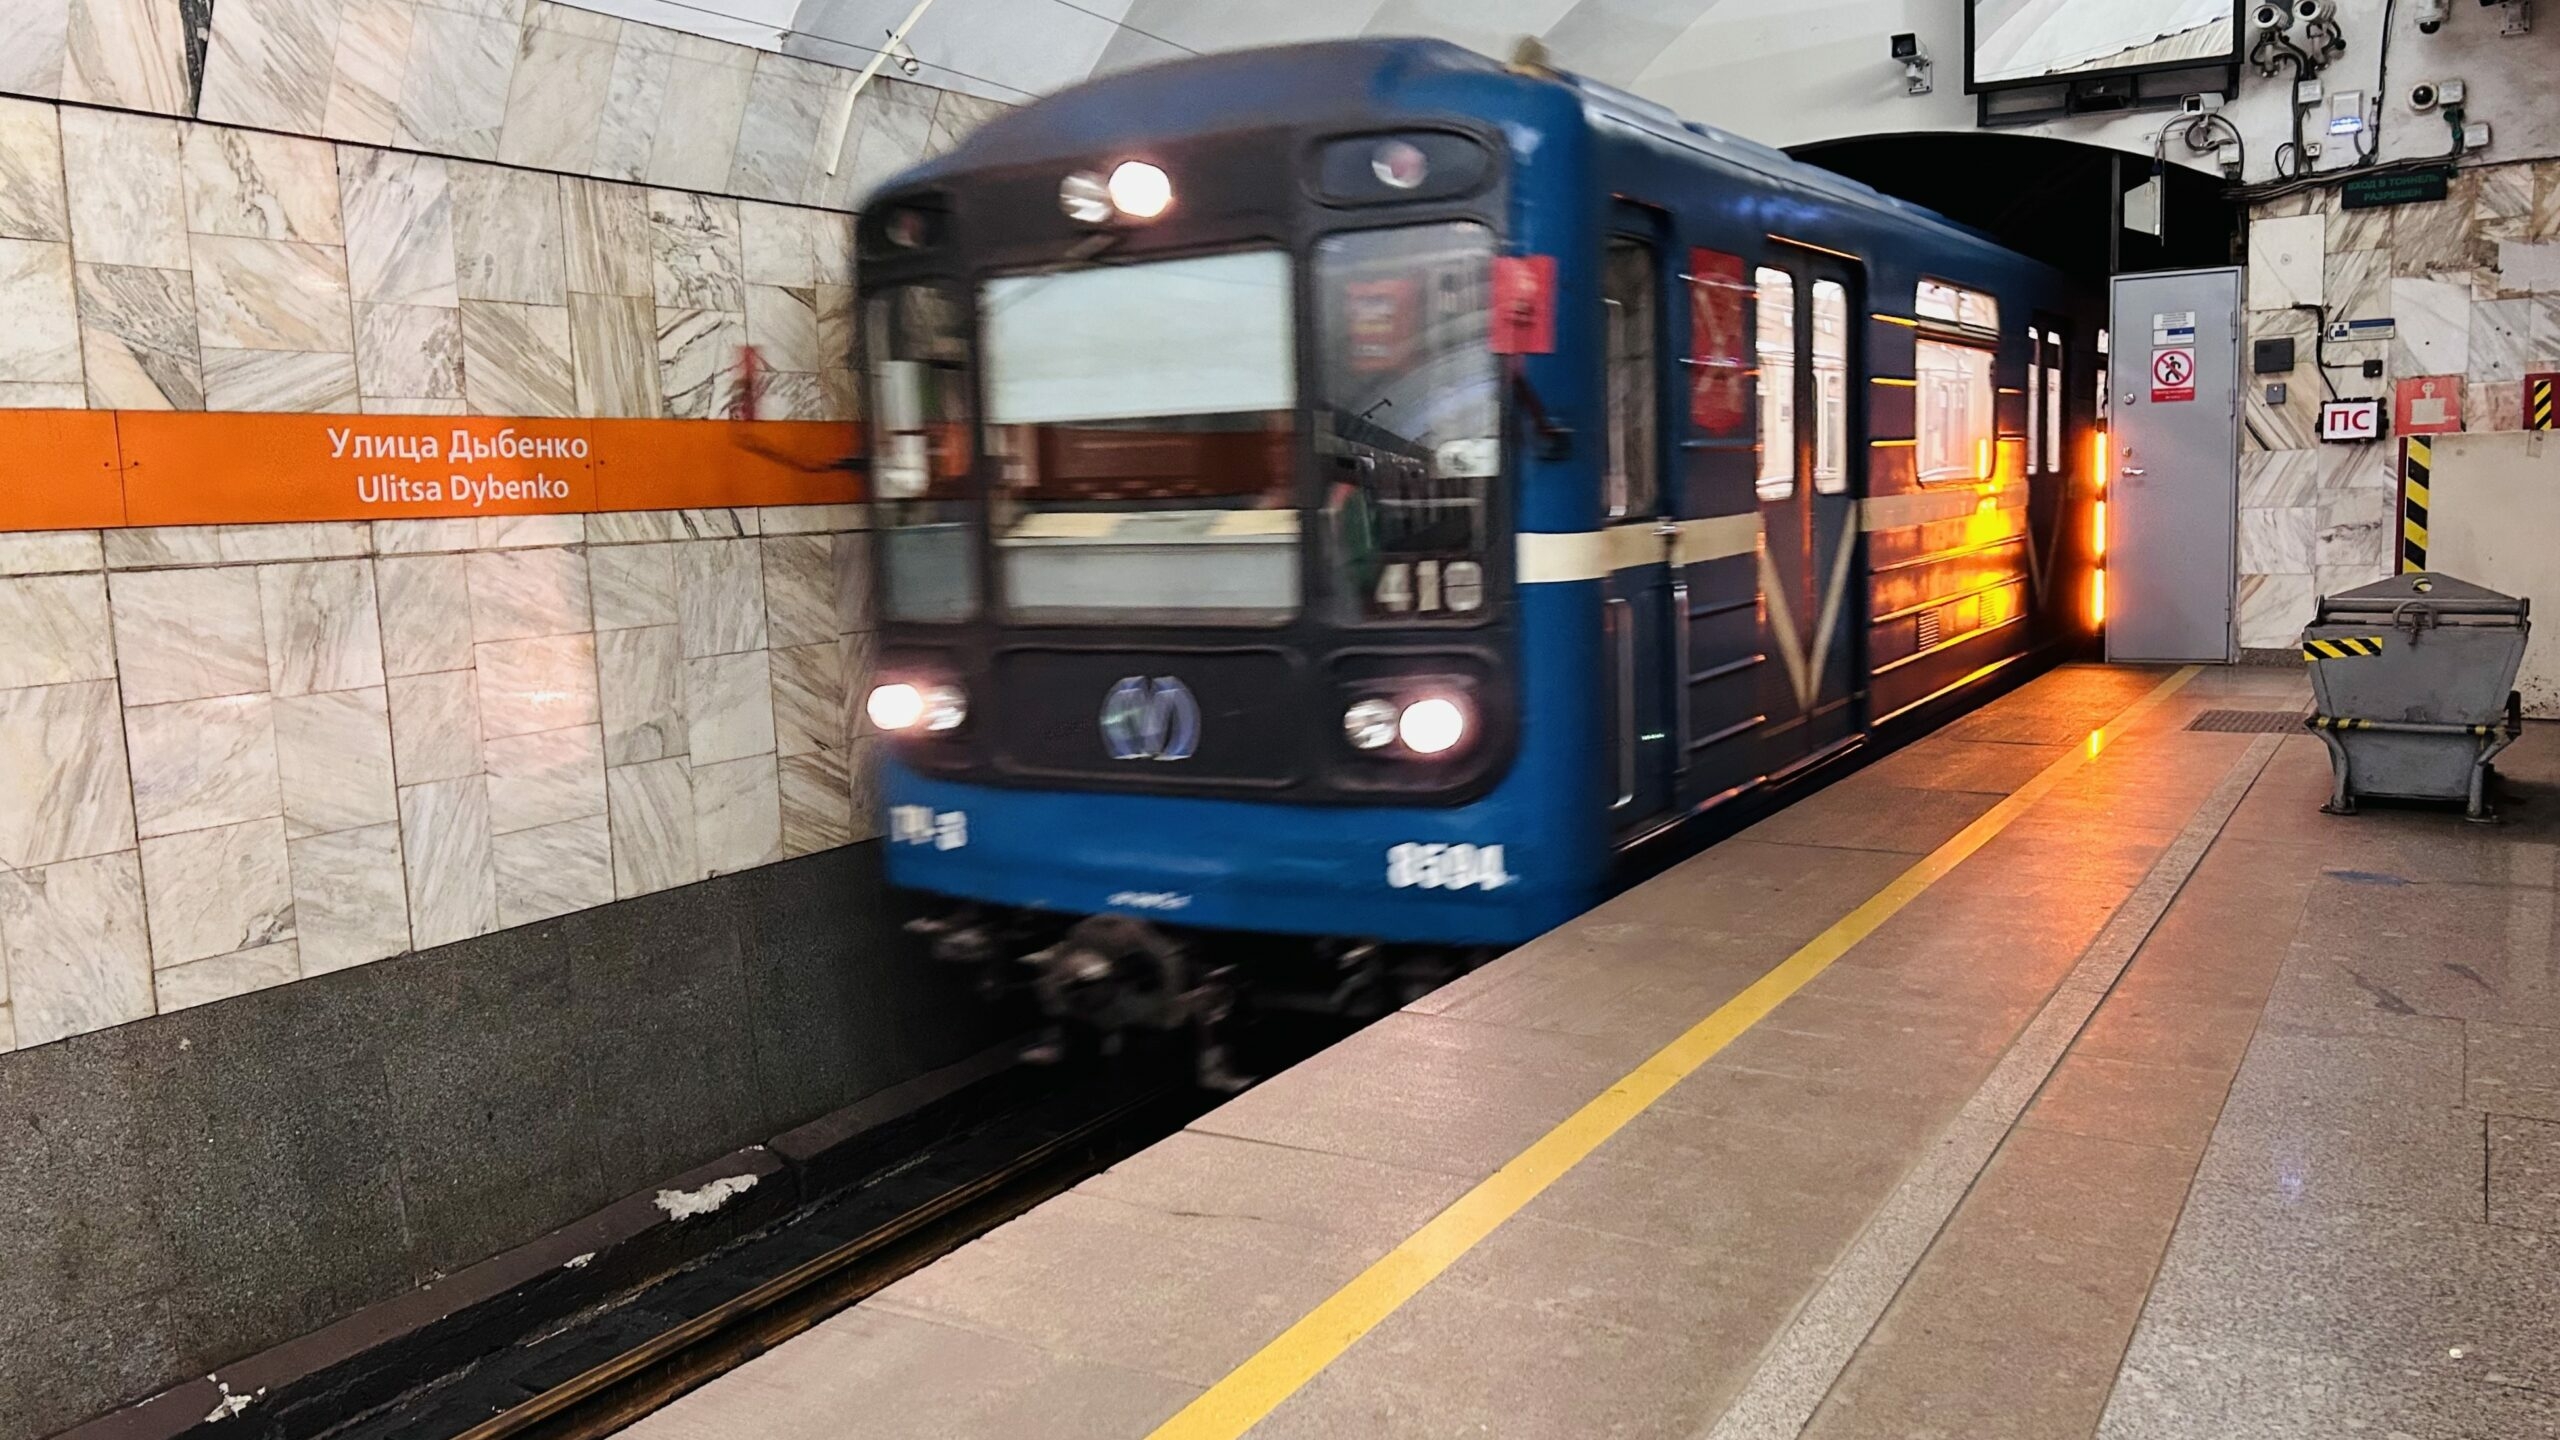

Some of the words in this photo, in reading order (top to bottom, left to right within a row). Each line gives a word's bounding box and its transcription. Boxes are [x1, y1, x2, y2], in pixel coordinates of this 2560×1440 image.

[2347, 179, 2376, 191] ВХОД
[2330, 410, 2370, 431] ПС
[327, 428, 439, 463] Улица
[449, 428, 588, 463] Дыбенко
[357, 474, 442, 503] Ulitsa
[450, 473, 569, 507] Dybenko
